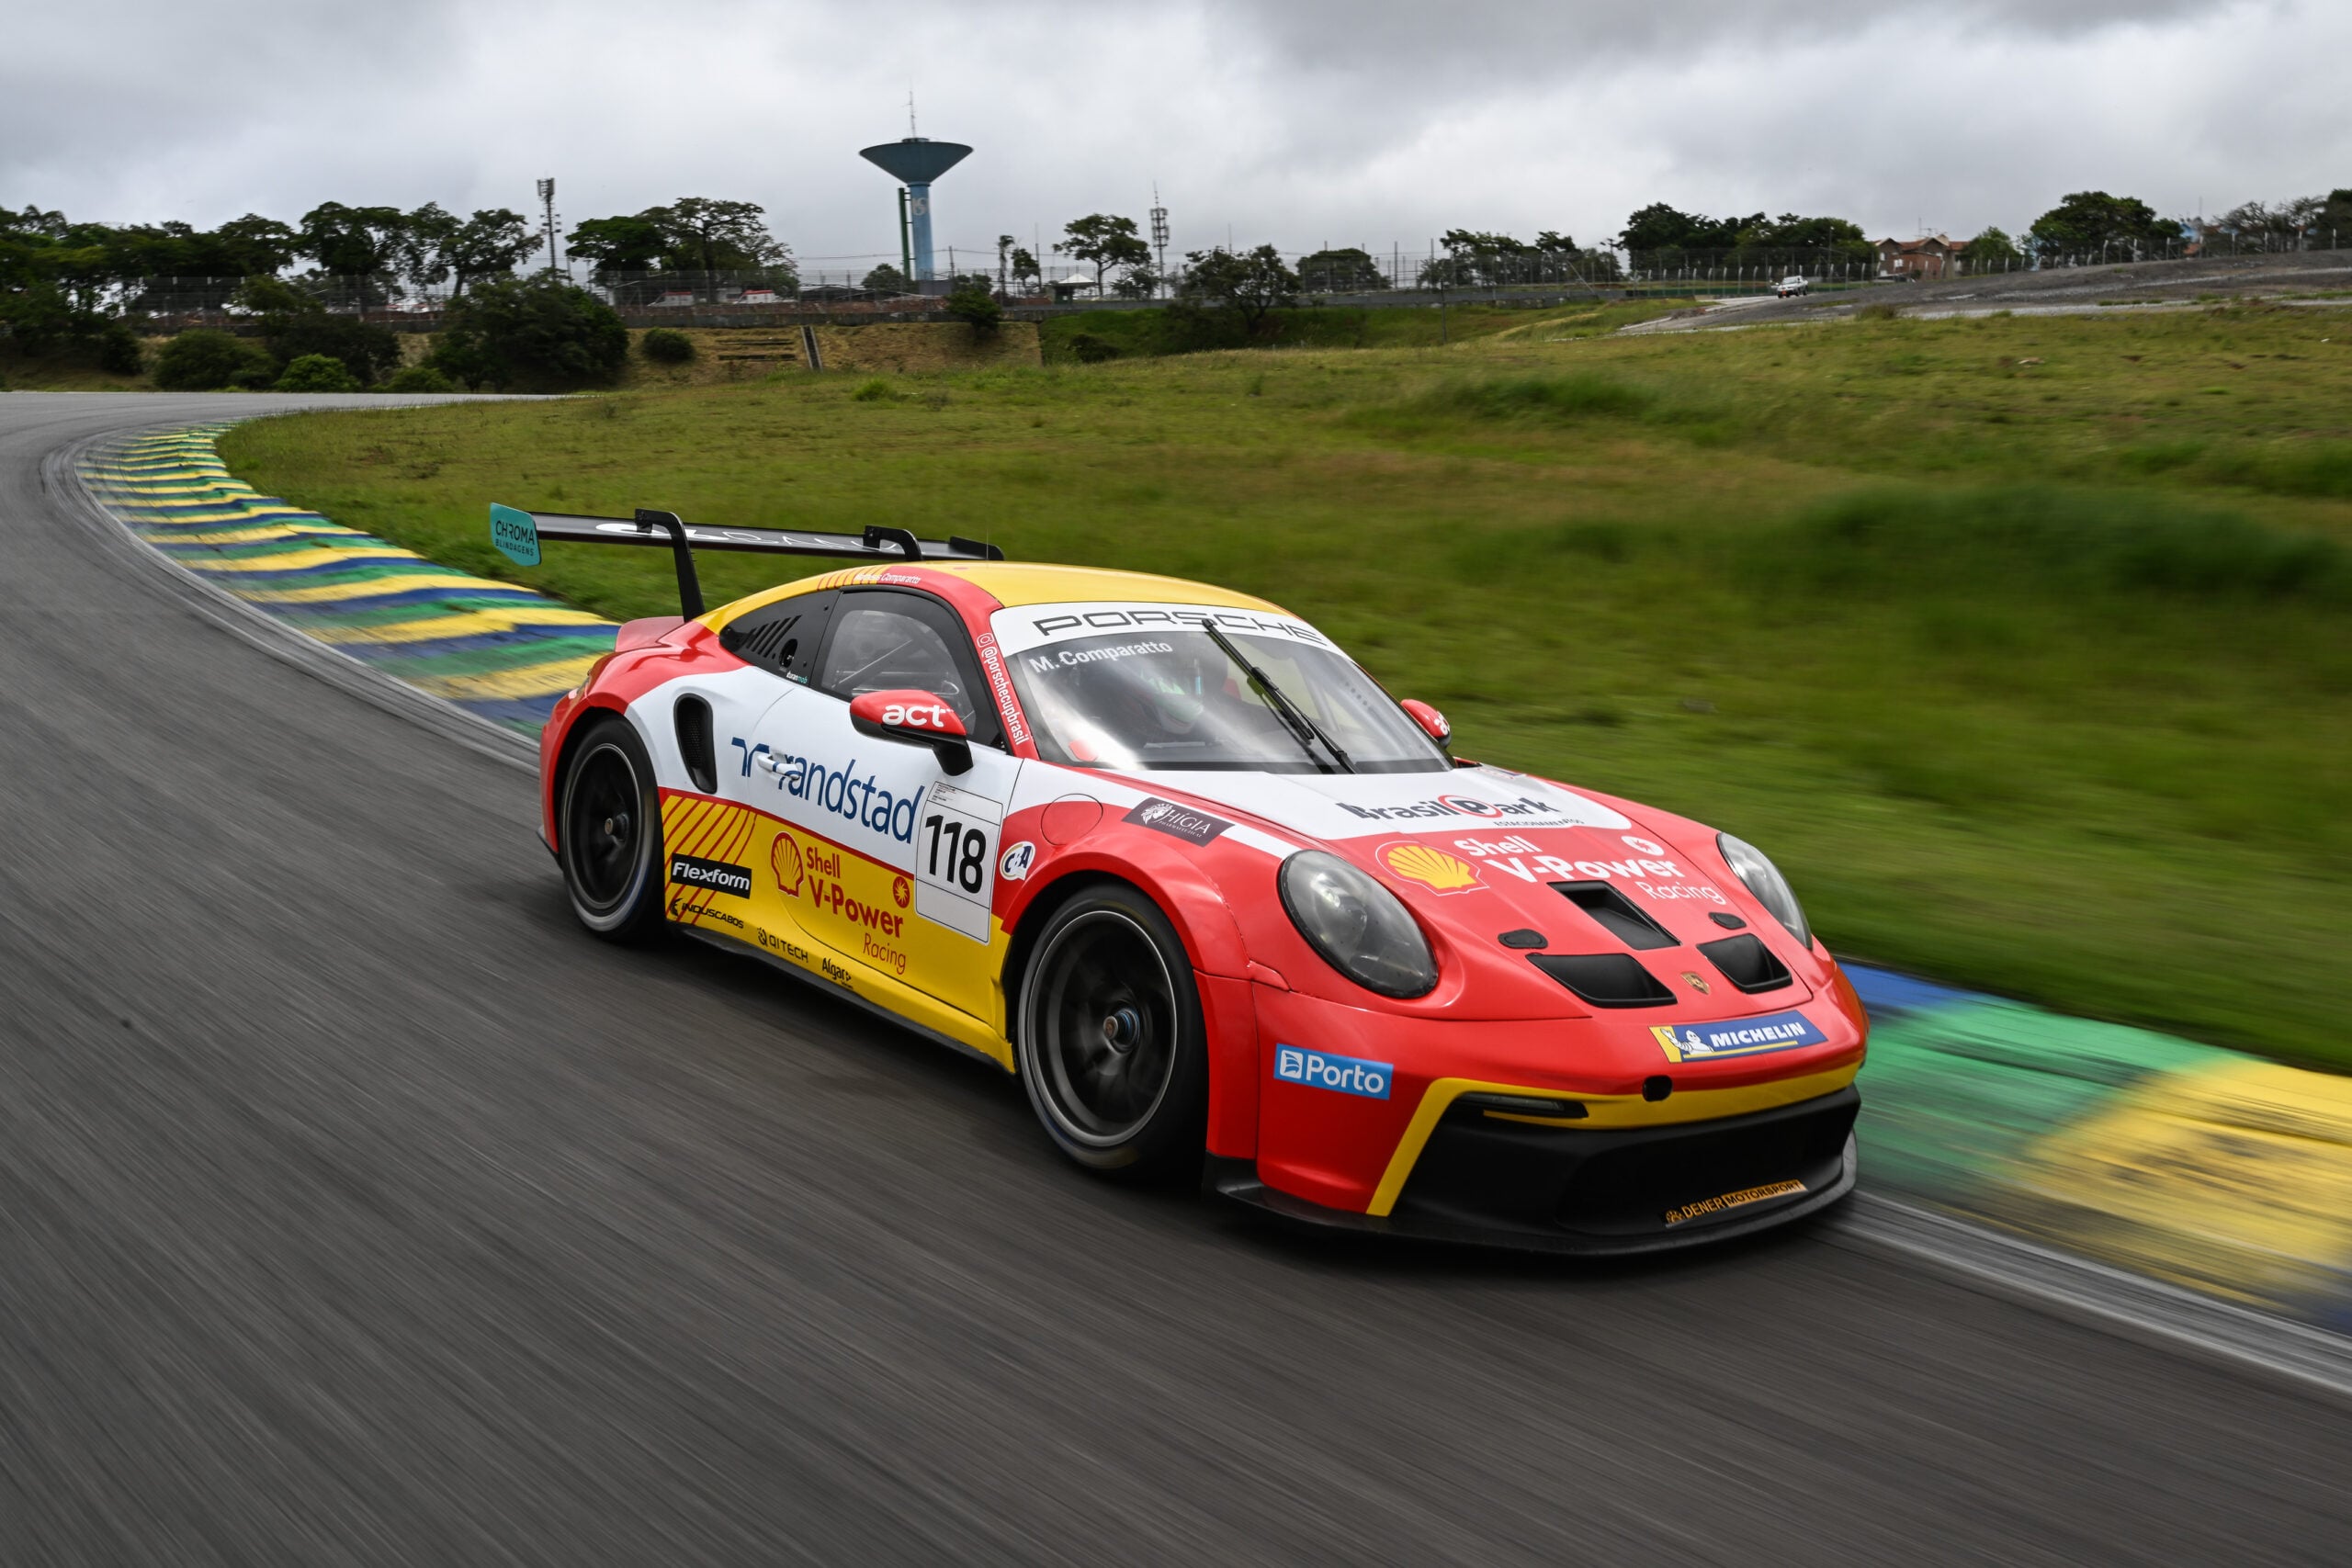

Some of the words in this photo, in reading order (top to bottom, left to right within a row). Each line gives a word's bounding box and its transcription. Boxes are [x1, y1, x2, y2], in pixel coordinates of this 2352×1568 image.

[495, 538, 535, 557] BLINDAGENS
[496, 520, 535, 545] CHROMA
[1033, 611, 1328, 646] PORSCHE
[1028, 656, 1058, 673] M.
[1057, 641, 1174, 666] Comparatto
[981, 646, 1030, 745] @porschecupbrasil
[925, 815, 986, 894] 118
[1453, 835, 1543, 857] Shell
[673, 862, 751, 890] Flexform
[806, 846, 841, 879] Shell
[1482, 855, 1686, 883] V-Power
[808, 874, 904, 939] V-Power
[1634, 880, 1727, 906] Racing
[681, 902, 744, 930] INDUSCABOS
[822, 957, 845, 980] Algar
[863, 931, 907, 976] Racing
[1709, 1021, 1807, 1047] MICHELIN
[1306, 1055, 1385, 1093] Porto
[1681, 1197, 1725, 1219] DENER
[1724, 1181, 1802, 1204] MOTORSPORT
